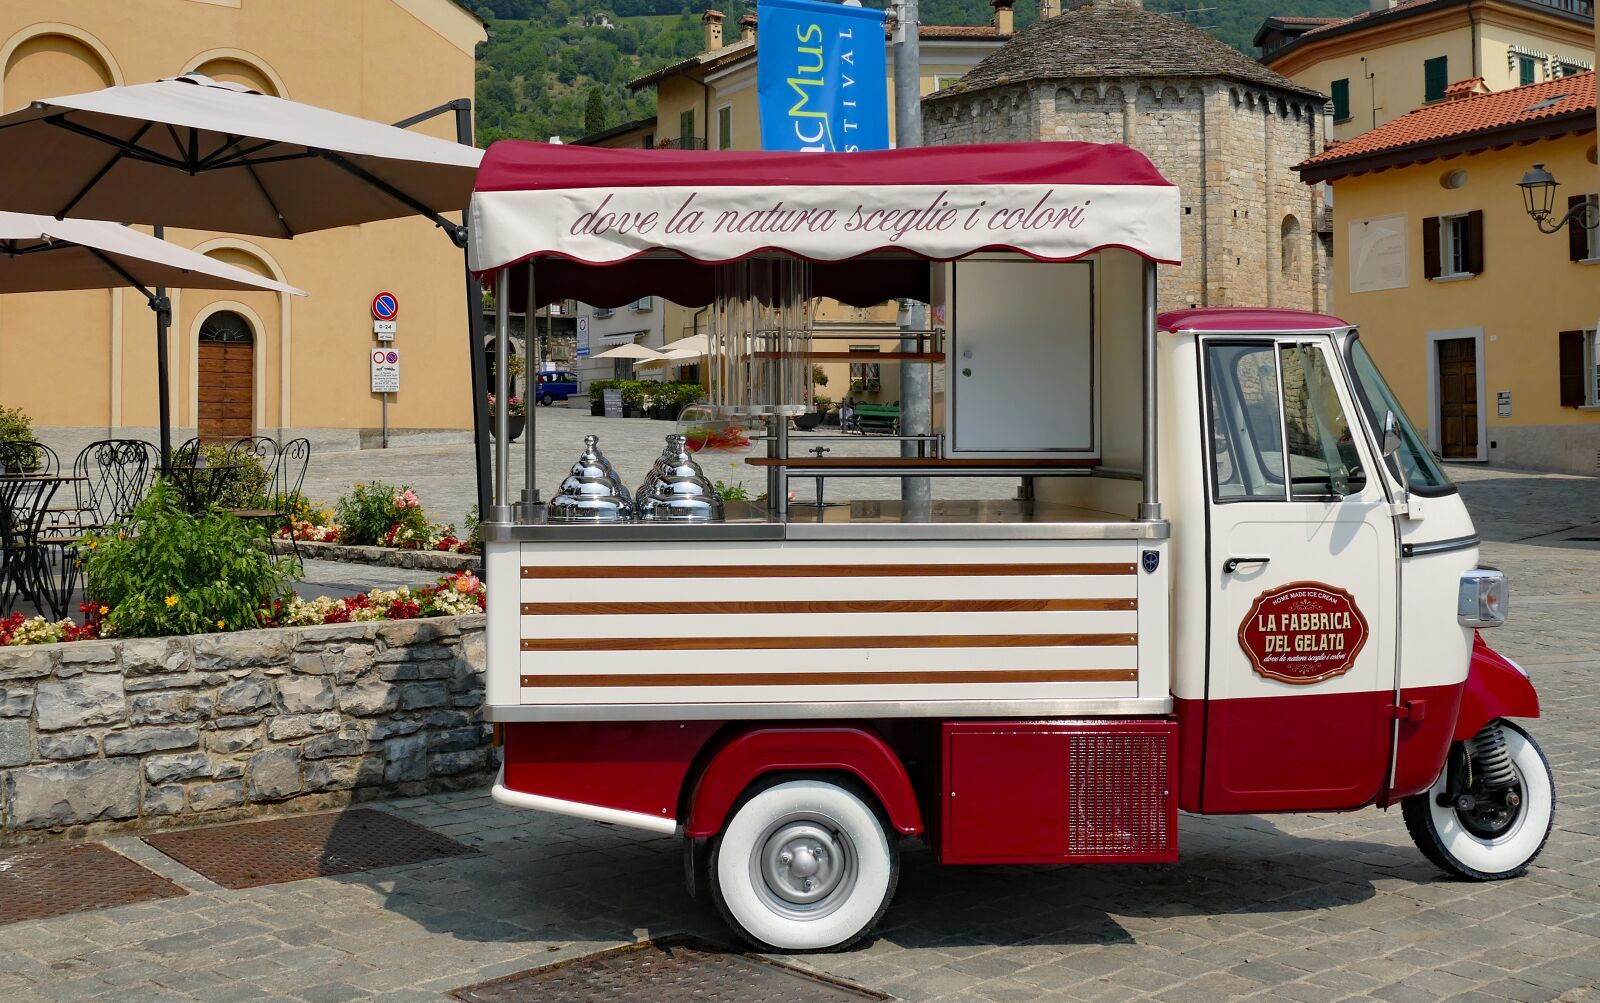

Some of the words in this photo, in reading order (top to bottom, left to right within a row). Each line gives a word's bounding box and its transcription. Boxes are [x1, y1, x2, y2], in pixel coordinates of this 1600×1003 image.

[570, 193, 659, 236] dove
[665, 192, 705, 234] la
[712, 201, 838, 233] natura
[844, 190, 958, 242] sceglie
[964, 201, 986, 231] i
[987, 189, 1091, 230] colori
[1272, 594, 1290, 606] HOME
[1290, 591, 1307, 599] MADE
[1317, 593, 1338, 605] CREAM
[1258, 614, 1277, 632] LA
[1281, 611, 1352, 632] FABBRICA
[1264, 635, 1291, 653] DEL
[1294, 633, 1345, 652] GELATO
[1263, 653, 1280, 662] dove
[1279, 653, 1287, 662] la
